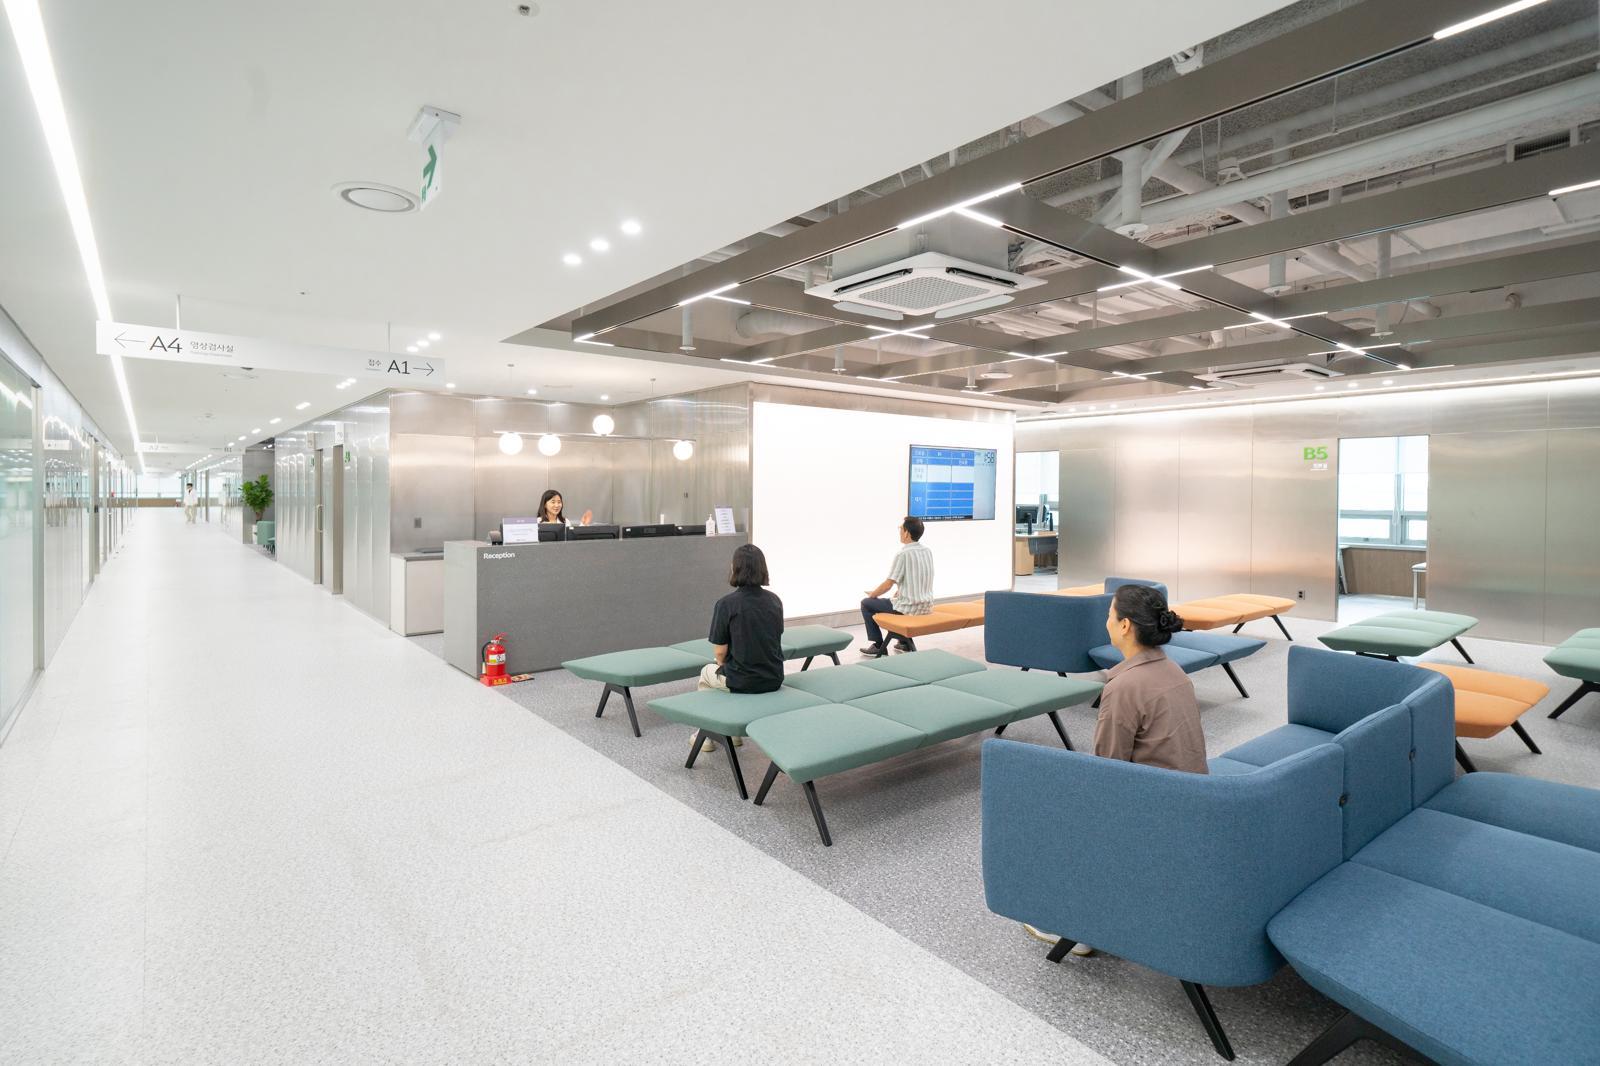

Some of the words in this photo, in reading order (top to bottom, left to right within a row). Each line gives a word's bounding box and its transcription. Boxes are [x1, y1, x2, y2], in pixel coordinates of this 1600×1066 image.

[149, 335, 183, 353] A4
[190, 341, 234, 353] 영상검사실
[387, 359, 411, 375] A1
[1304, 446, 1328, 461] B5
[483, 551, 516, 561] Reception
